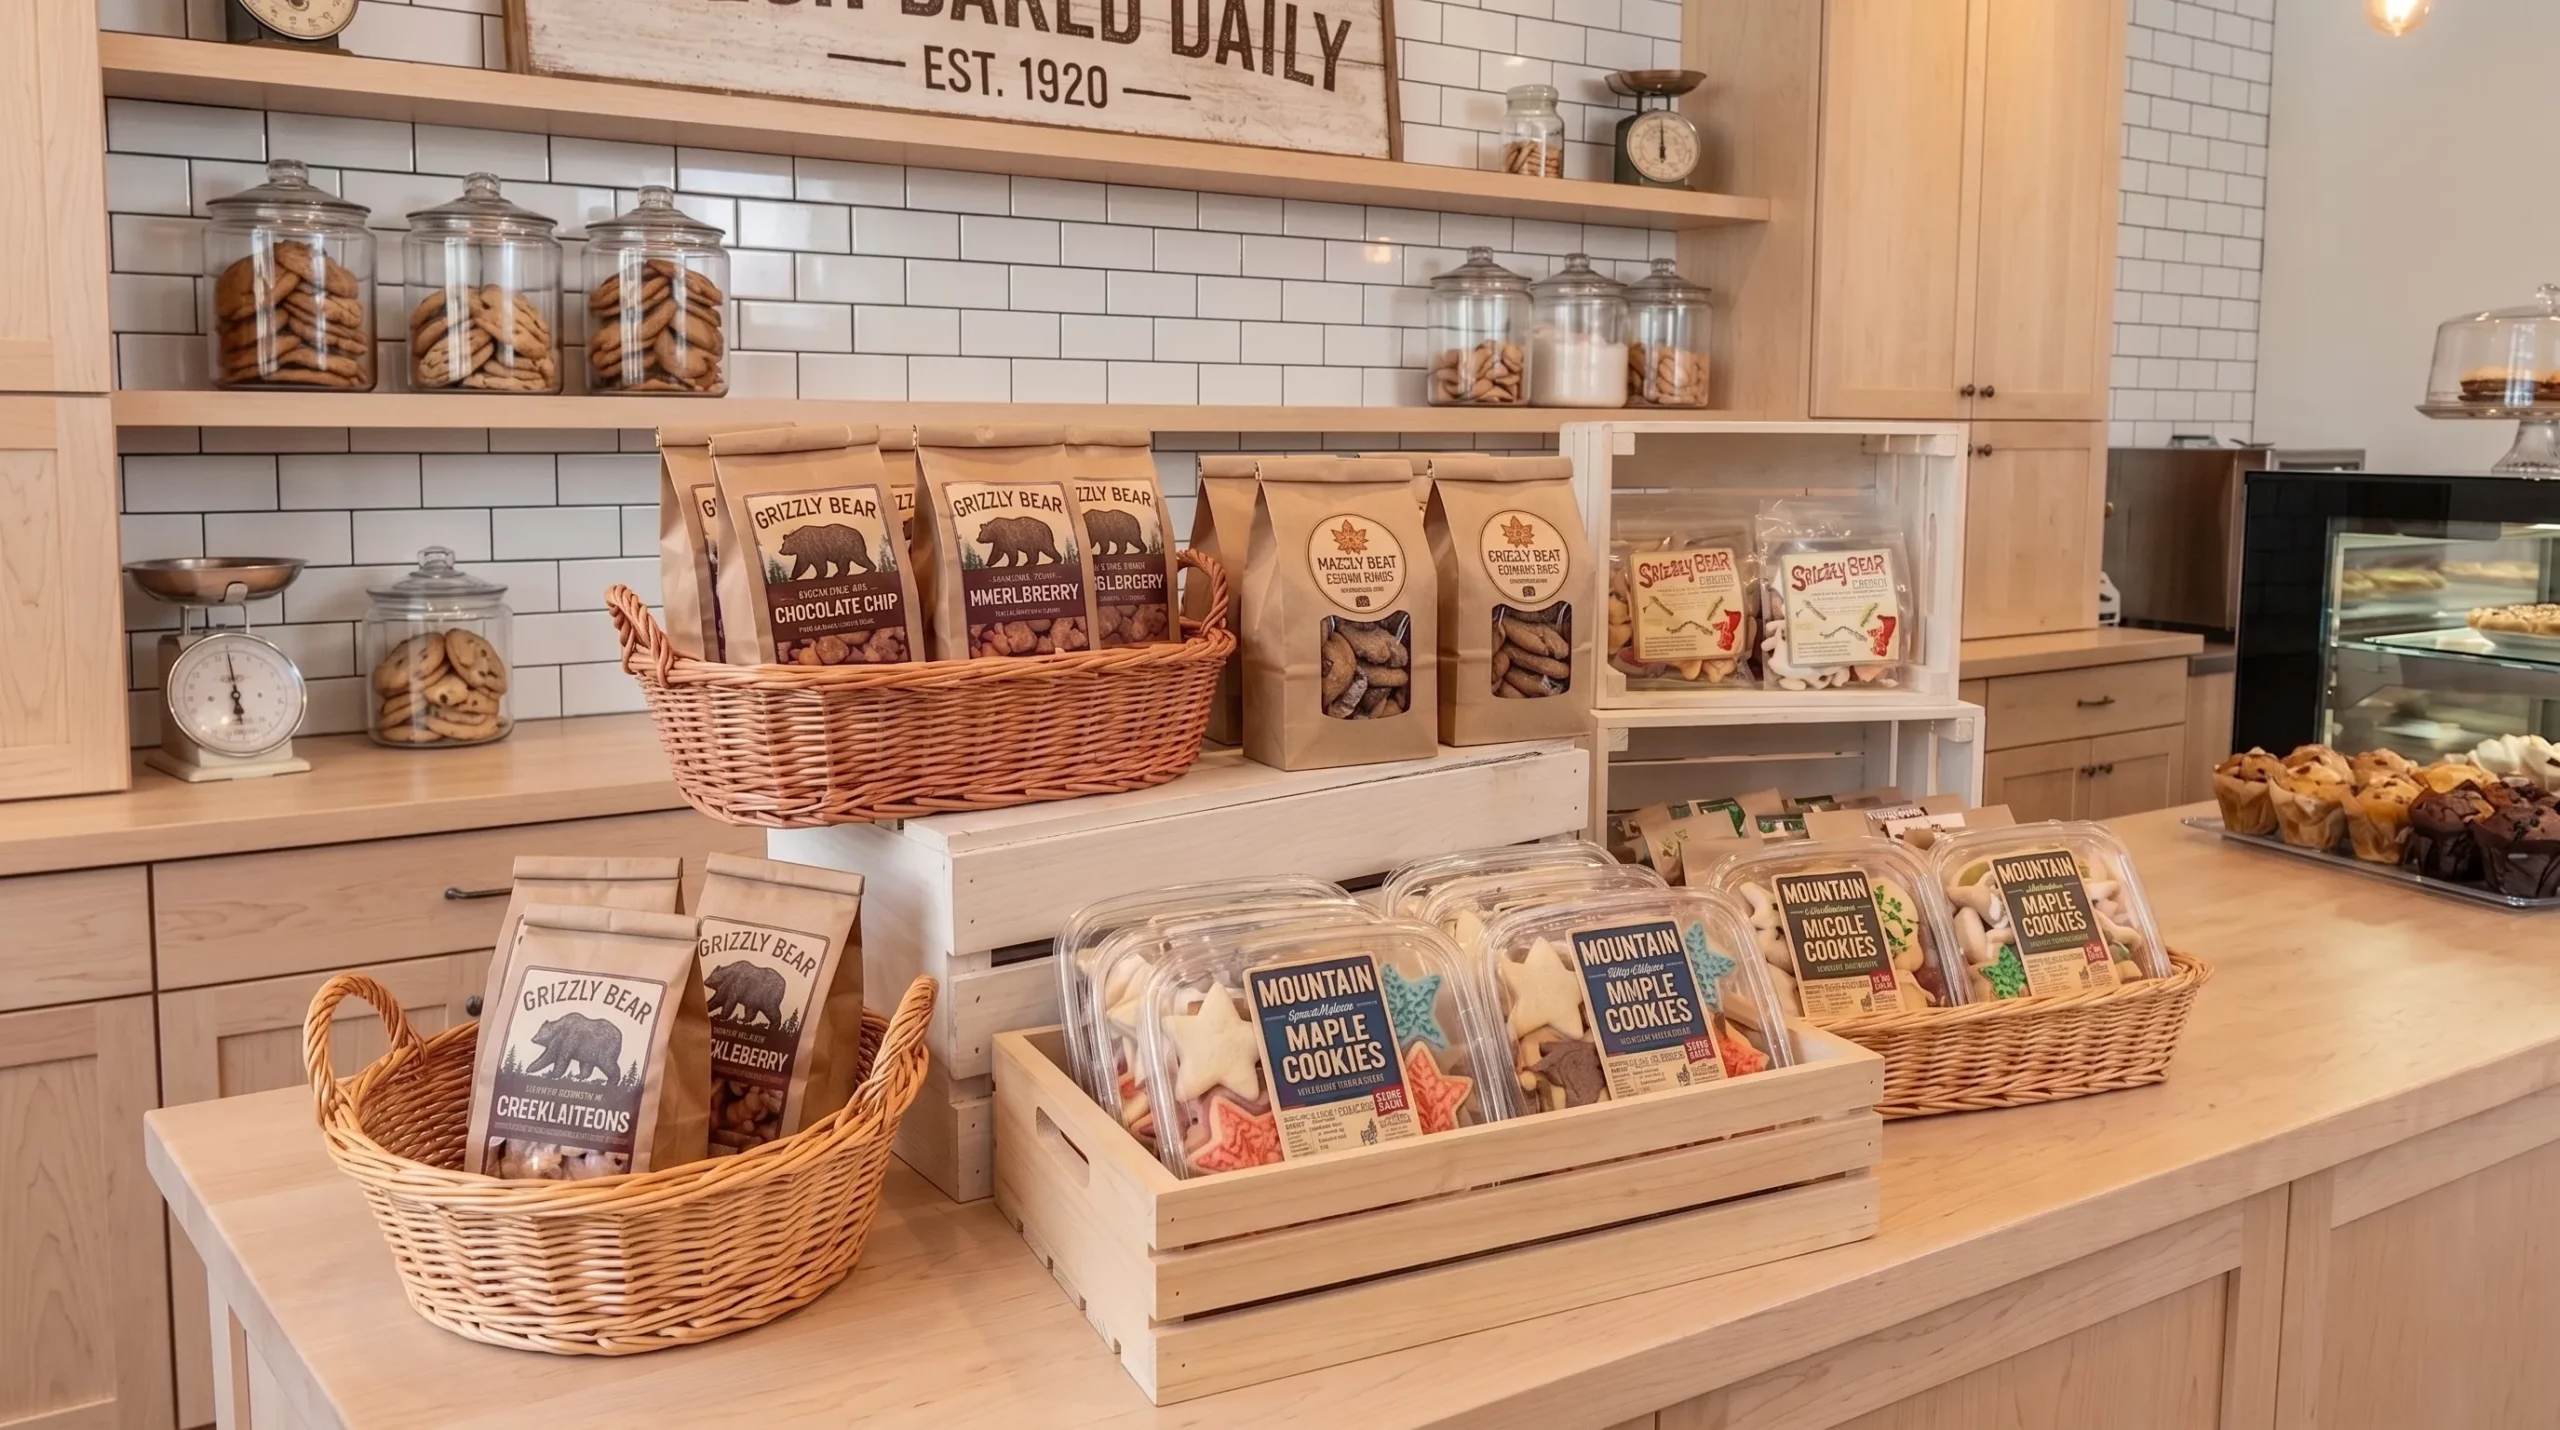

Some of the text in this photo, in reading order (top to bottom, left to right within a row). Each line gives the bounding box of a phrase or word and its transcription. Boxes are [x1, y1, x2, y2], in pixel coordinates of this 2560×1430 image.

[1172, 0, 1352, 92] DAILY
[924, 45, 1108, 109] EST. 1920
[953, 490, 1063, 518] GRIZZLY BEAR
[1075, 486, 1151, 507] ZZLY BEAR
[755, 497, 822, 530] GRIZZLY
[829, 496, 876, 519] BEAR
[1366, 555, 1396, 570] BEAT
[1533, 549, 1561, 562] BEAT
[1694, 551, 1732, 573] BEAR
[1847, 554, 1886, 576] BEAR
[775, 592, 898, 624] CHOCOLATE CHIP
[1997, 856, 2076, 885] MOUNTAIN
[1781, 877, 1868, 904] MOUNTAIN
[2021, 891, 2077, 916] MAPLE
[1801, 914, 1869, 939] MICOLE
[2021, 910, 2087, 938] COOKIES
[699, 931, 817, 978] GRIZZLY BEAR
[1578, 928, 1681, 967] MOUNTAIN
[1803, 935, 1878, 963] COOKIES
[523, 979, 652, 1026] GRIZZLY BEAR
[1257, 964, 1376, 1009] MOUNTAIN
[1605, 973, 1679, 1006] MMPLE
[1604, 997, 1693, 1034] COOKIES
[1285, 1013, 1371, 1053] MAPLE
[1282, 1041, 1387, 1085] COOKIES
[496, 1094, 631, 1134] CREEKLAITEONS
